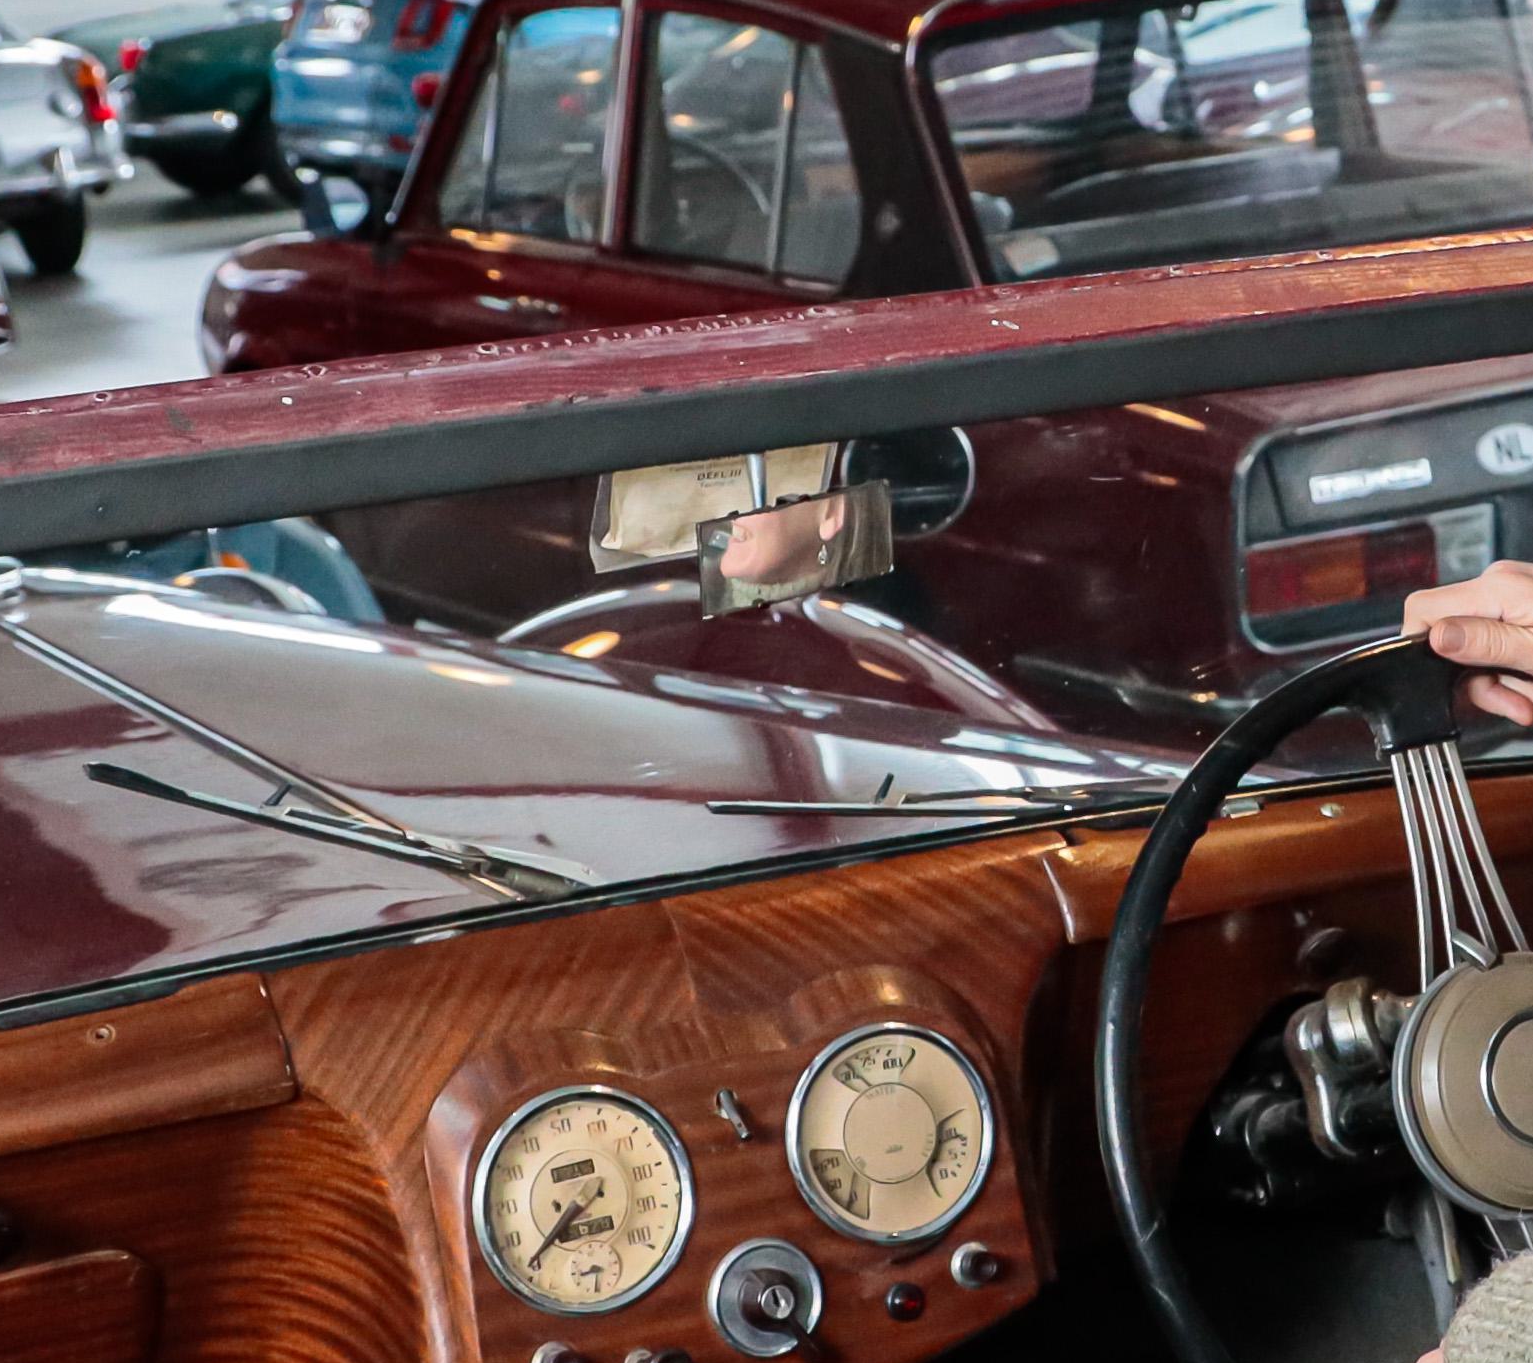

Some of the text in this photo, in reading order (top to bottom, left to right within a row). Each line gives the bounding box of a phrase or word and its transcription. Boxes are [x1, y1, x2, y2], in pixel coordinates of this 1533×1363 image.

[1495, 435, 1533, 464] NL
[550, 1118, 571, 1136] 50
[587, 1119, 607, 1136] 60
[632, 1163, 653, 1183] 80
[636, 1194, 657, 1214] 90
[627, 1225, 652, 1246] 100
